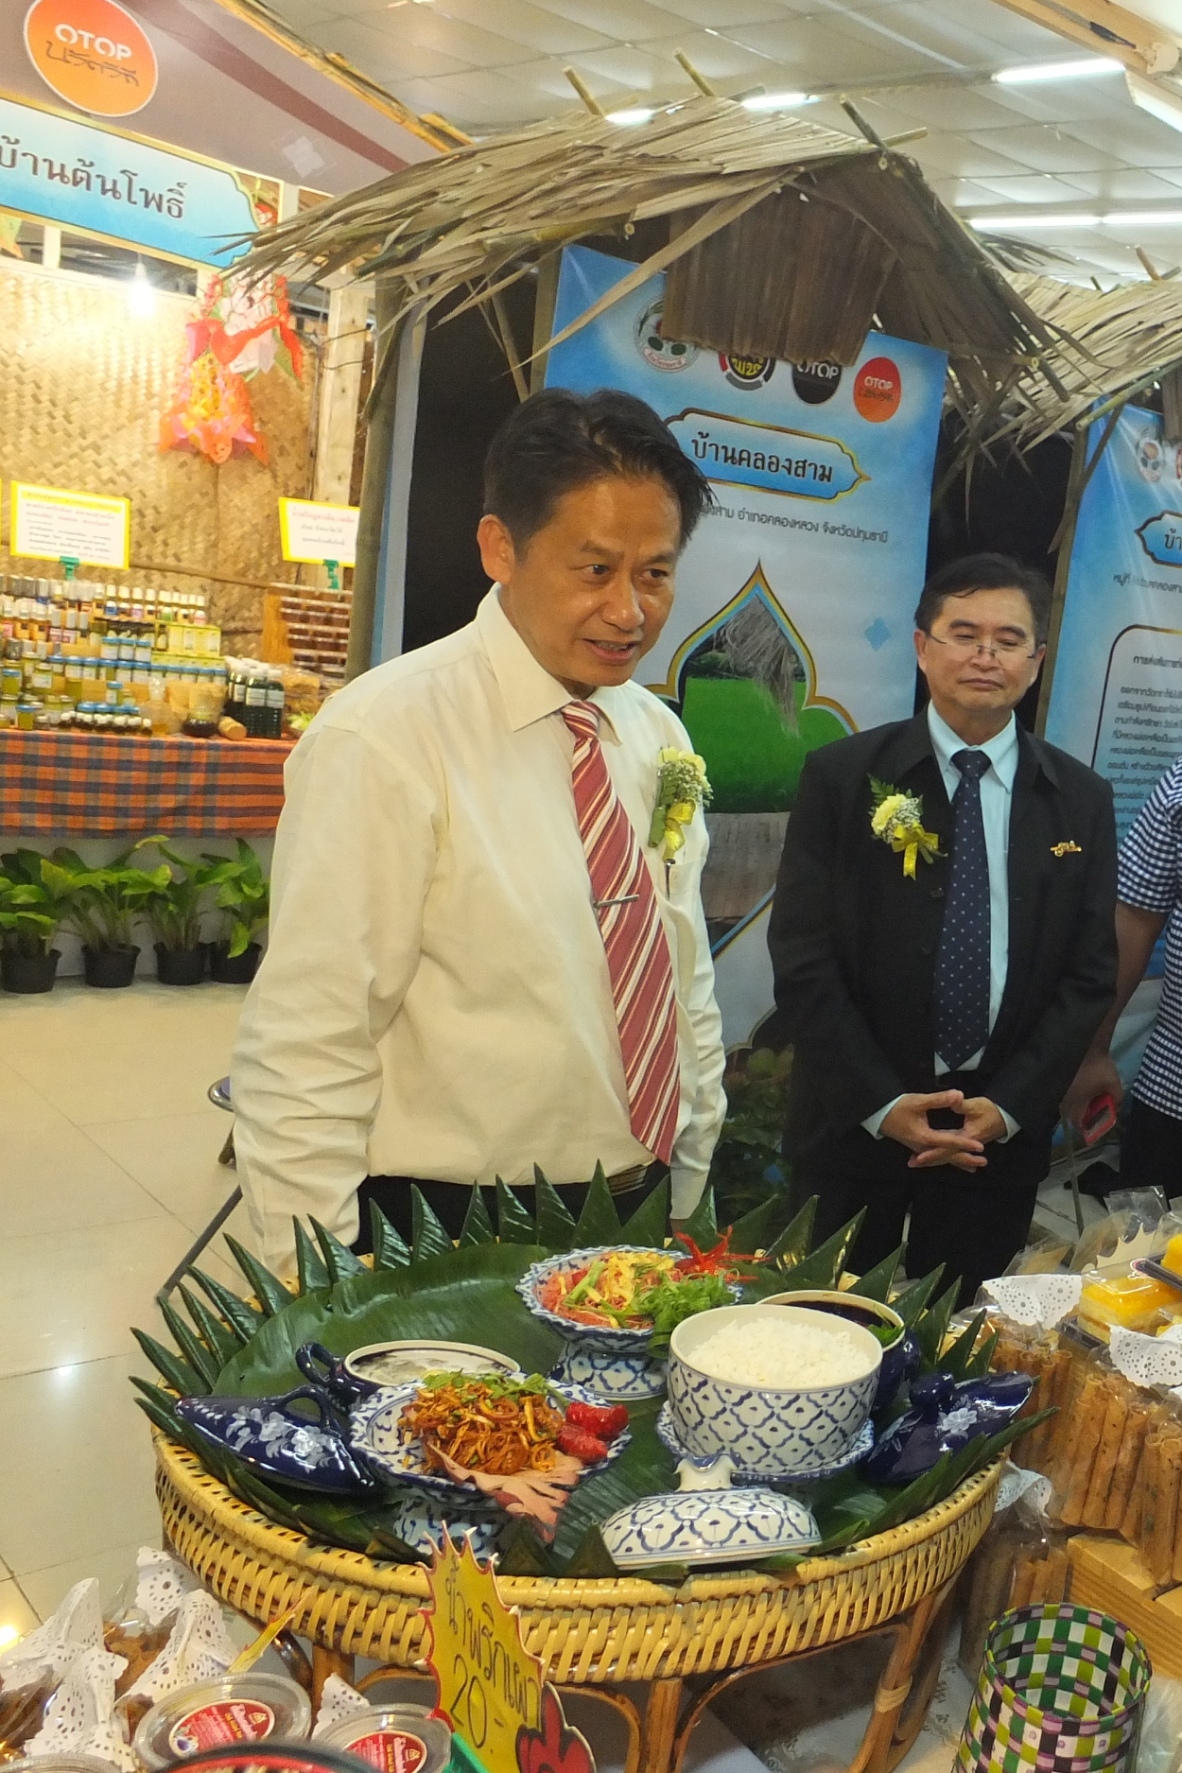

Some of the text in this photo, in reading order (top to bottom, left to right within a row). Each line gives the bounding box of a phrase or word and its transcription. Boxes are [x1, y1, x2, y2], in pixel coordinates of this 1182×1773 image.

[54, 24, 132, 61] OTOP
[0, 135, 187, 219] บ้านต้นโพธิ์
[797, 360, 840, 380] OTOP
[864, 375, 894, 391] OTOP
[691, 431, 833, 482] บ้านคลองสาม
